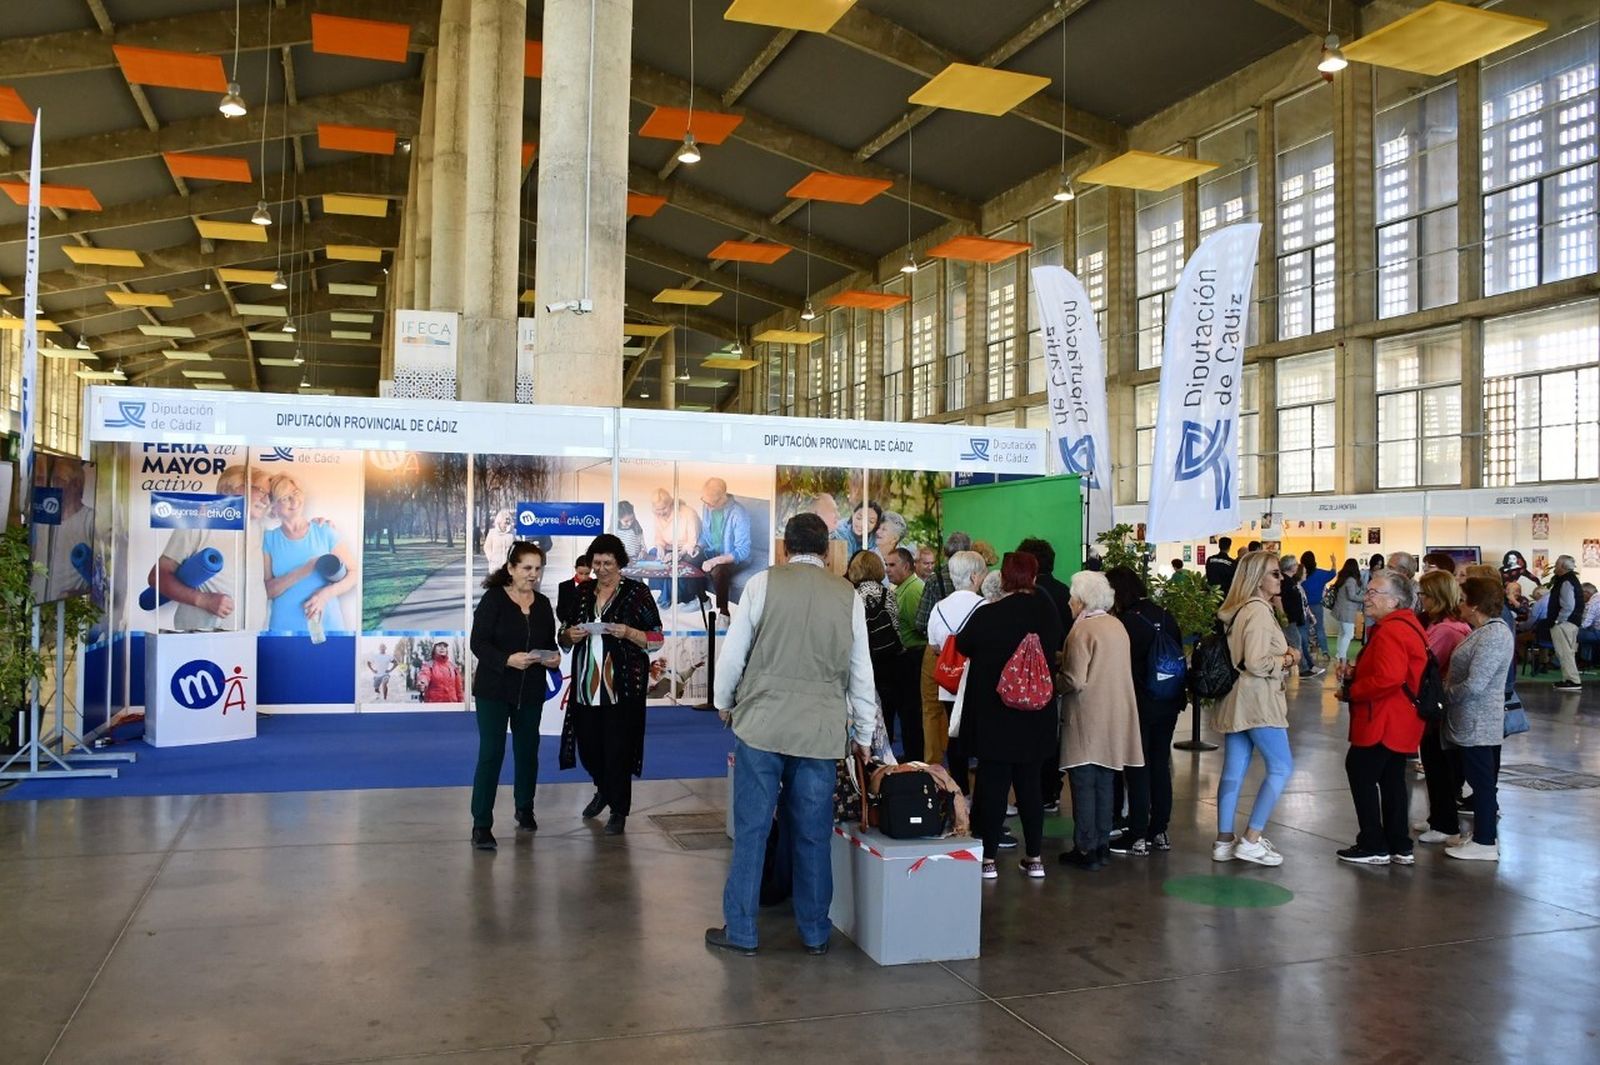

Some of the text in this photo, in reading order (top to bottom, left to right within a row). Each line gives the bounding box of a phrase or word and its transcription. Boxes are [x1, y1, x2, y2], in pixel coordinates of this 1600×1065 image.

[401, 320, 451, 335] IFECA
[1214, 374, 1232, 405] de
[151, 401, 214, 416] Diputación
[151, 417, 202, 431] de Cádiz
[276, 412, 458, 433] DIPUTACIÓN PROVINCIAL DE CÁDIZ
[143, 442, 209, 454] FERIA
[764, 433, 914, 453] DIPUTACIÓN PROVINCIAL DE CÁDIZ
[141, 456, 227, 475] MAYOR
[141, 476, 203, 492] activo
